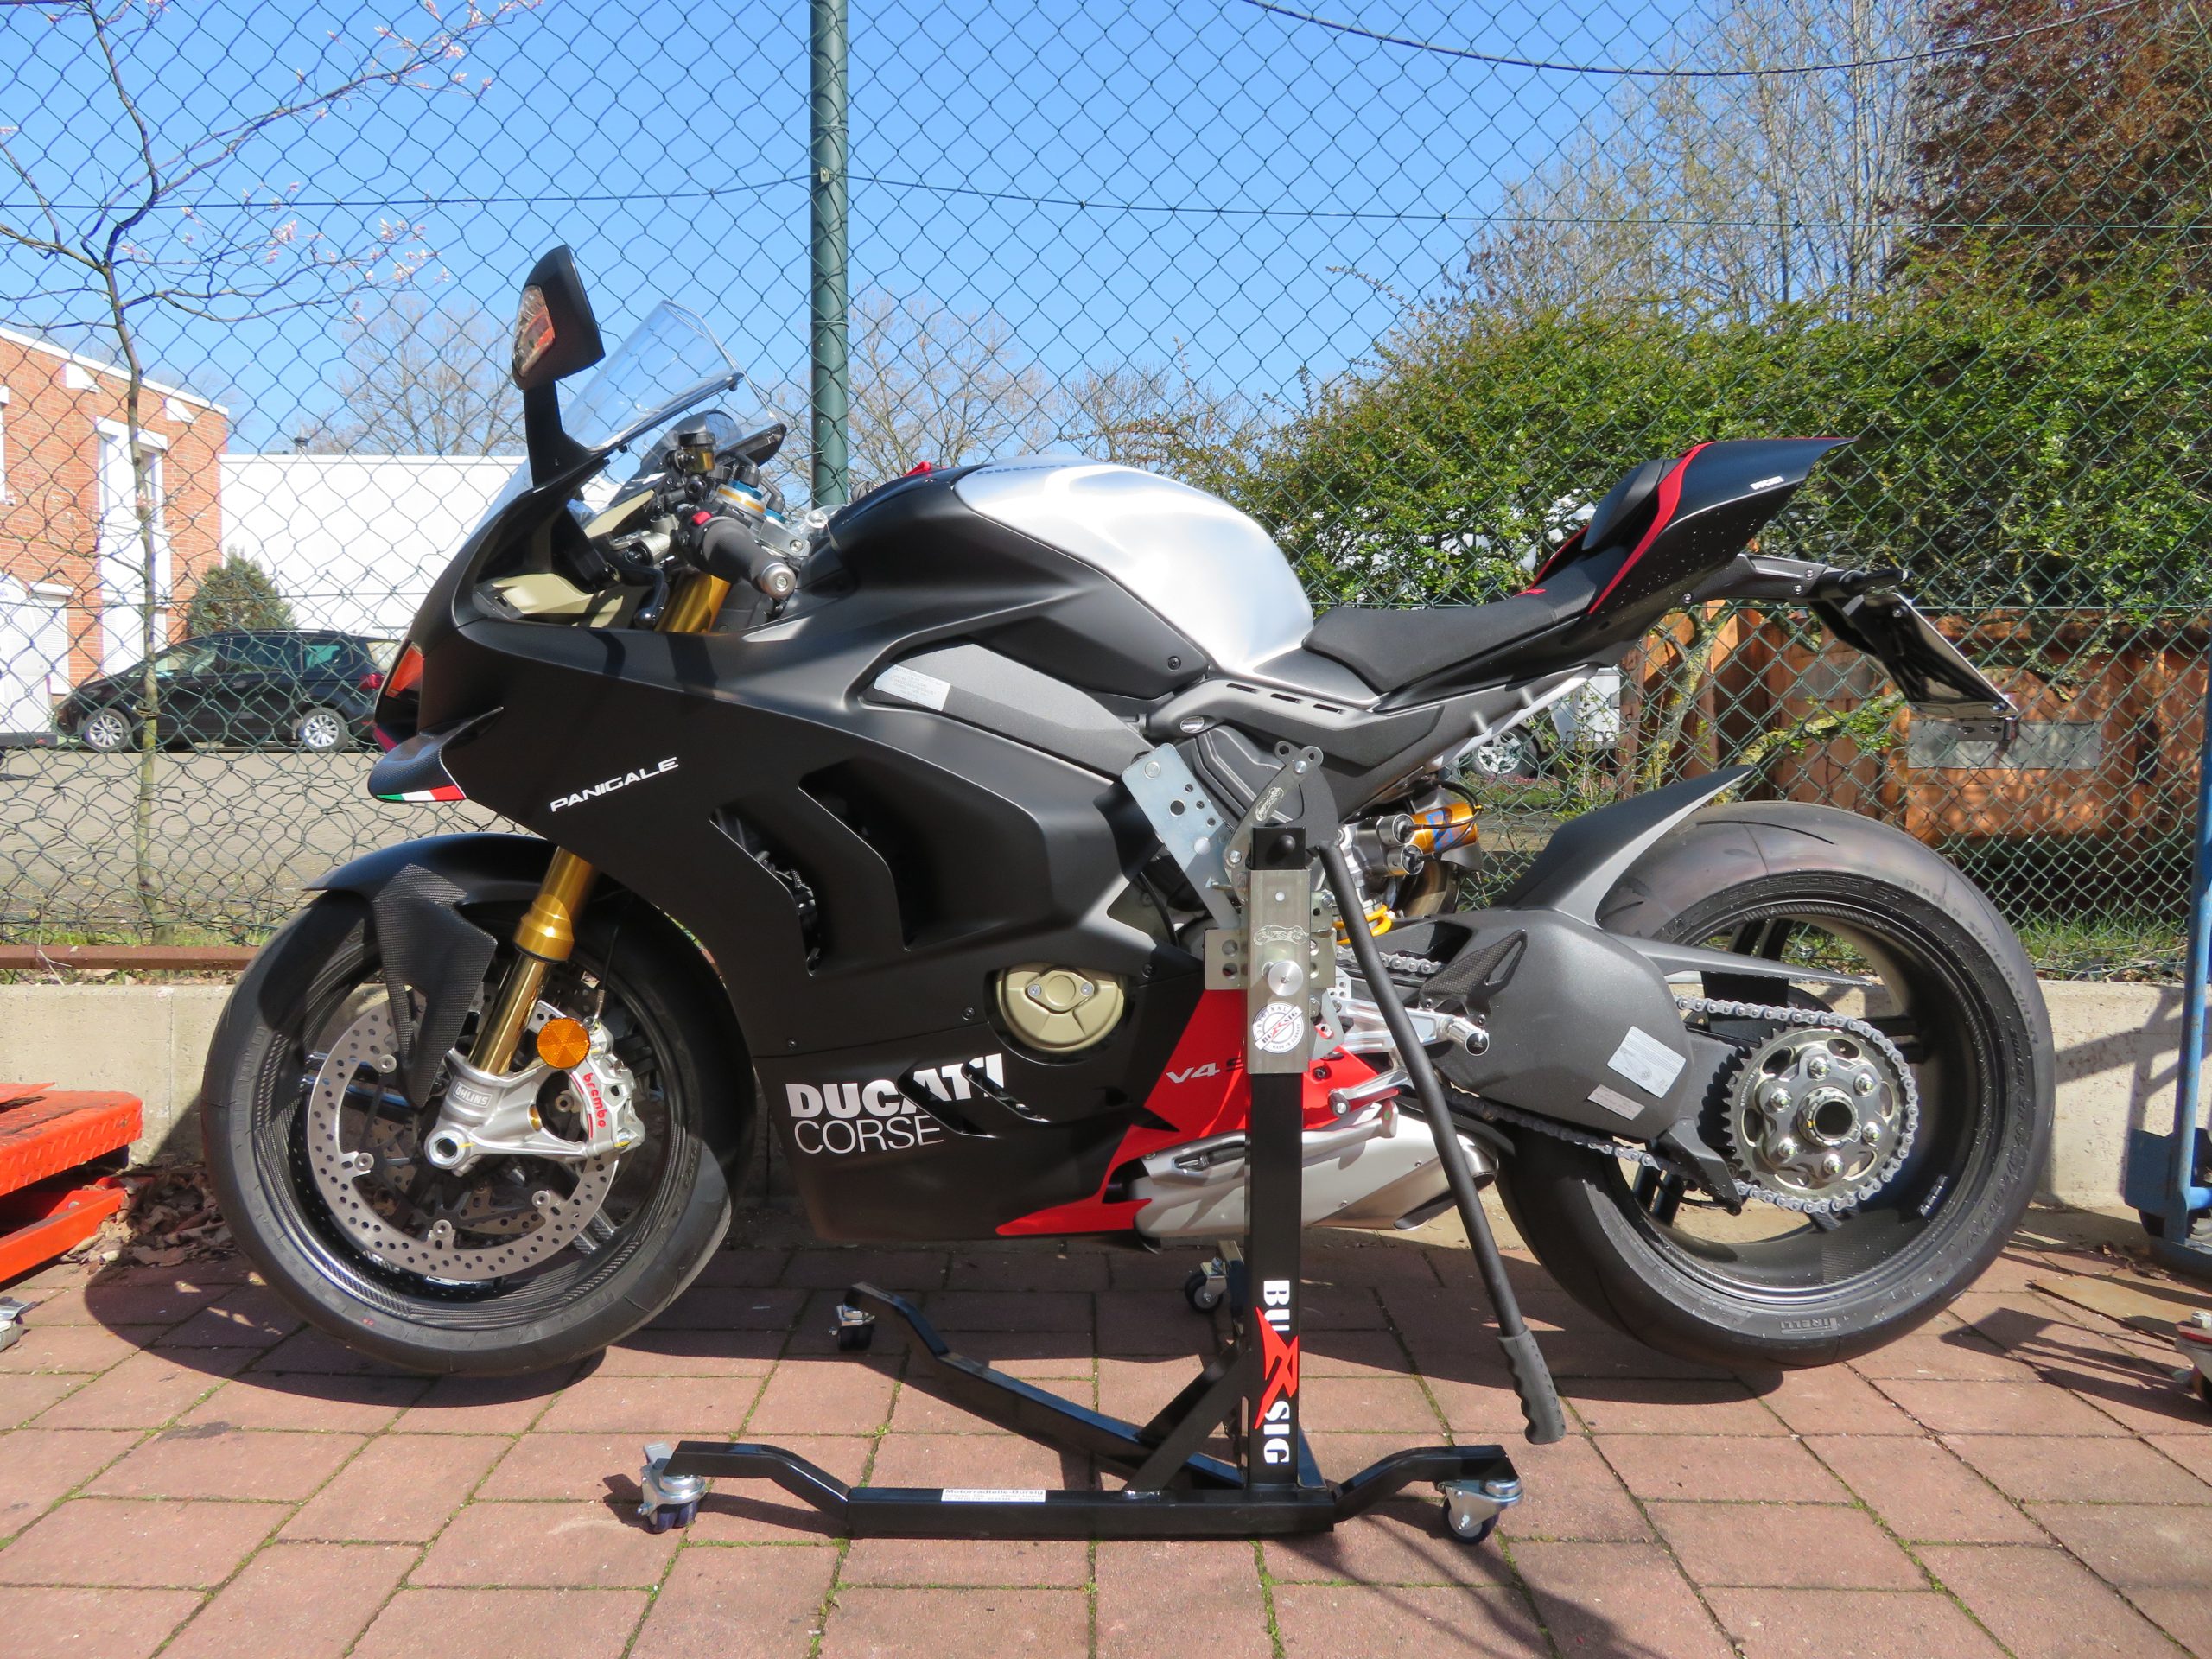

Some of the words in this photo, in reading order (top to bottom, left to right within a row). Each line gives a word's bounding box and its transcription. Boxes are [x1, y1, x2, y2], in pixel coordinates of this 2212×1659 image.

[550, 756, 679, 812] PANIGALE
[785, 1053, 1004, 1118] DUCATI
[1166, 1062, 1221, 1084] V4
[455, 1083, 489, 1106] ÖHLINS
[583, 1072, 607, 1128] brembo
[794, 1115, 944, 1154] CORSE
[1780, 1318, 1838, 1334] PIRELLI
